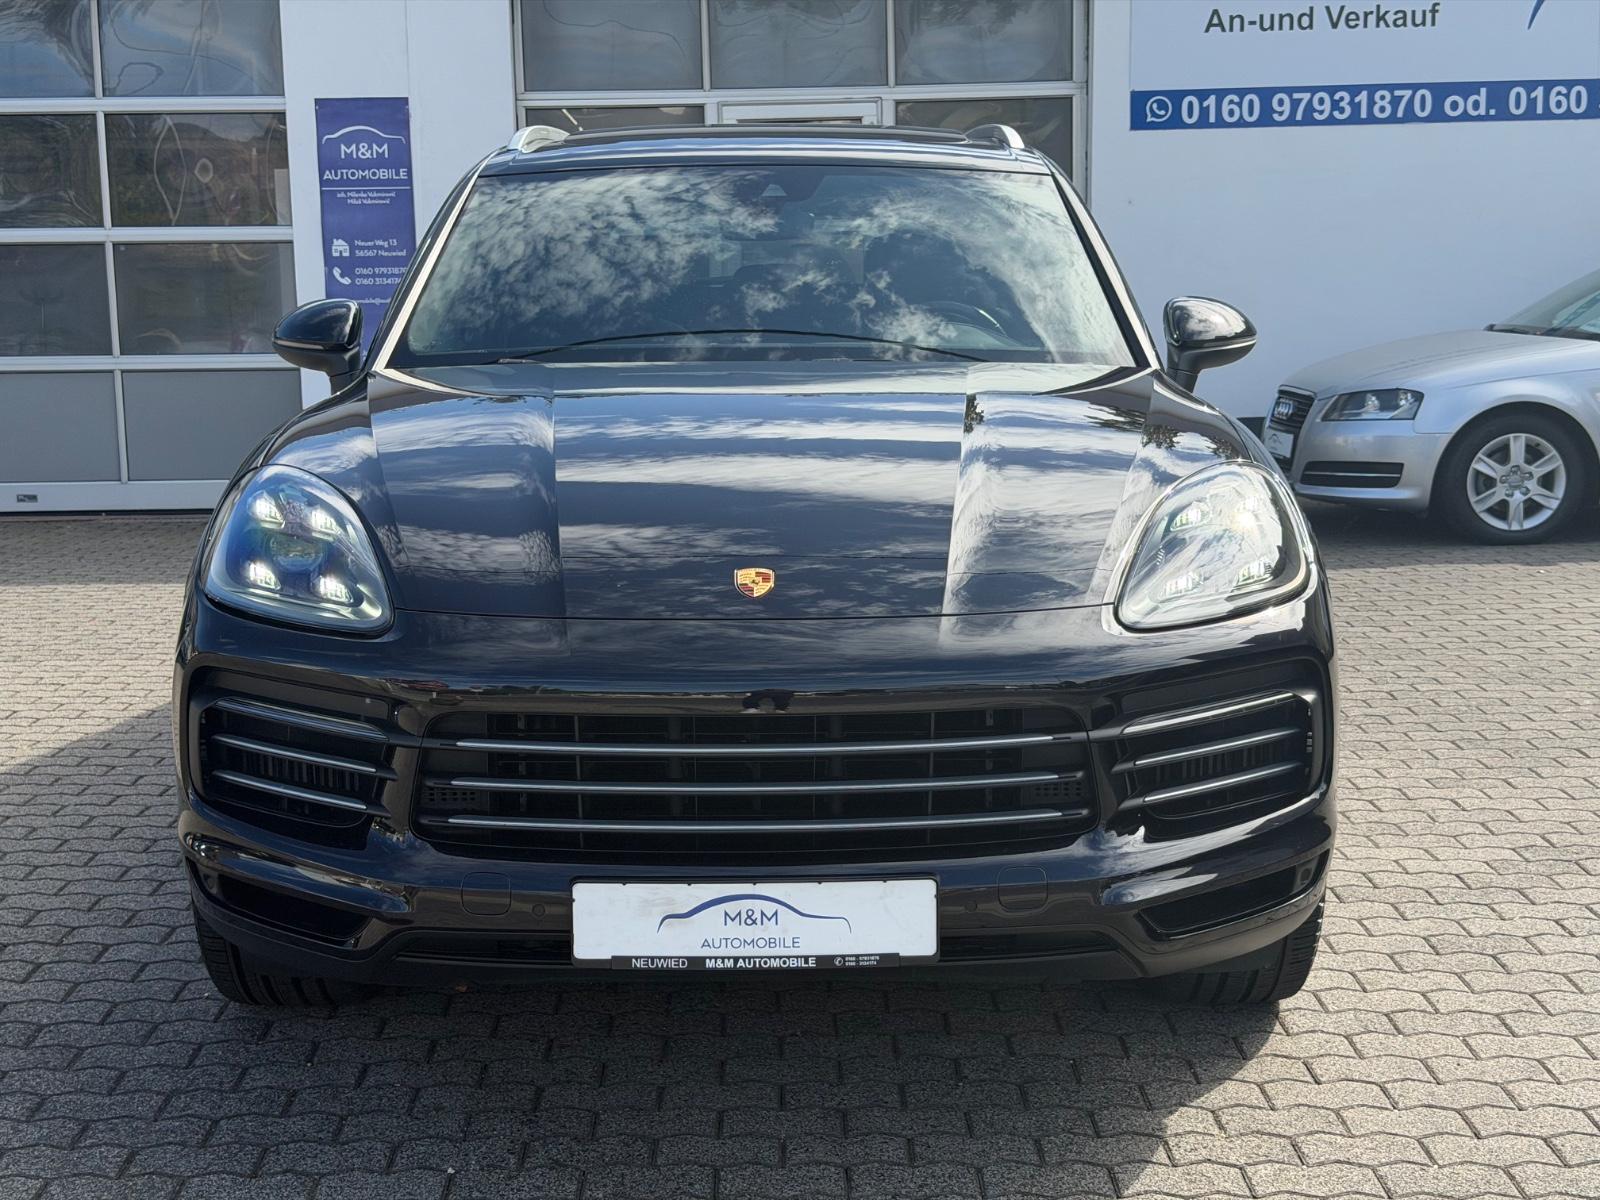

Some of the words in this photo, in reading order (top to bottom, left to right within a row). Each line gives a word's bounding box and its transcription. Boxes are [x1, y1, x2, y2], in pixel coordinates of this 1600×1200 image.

[1203, 5, 1315, 34] An-und
[1324, 2, 1441, 30] Verkauf
[1180, 94, 1261, 125] 0160
[1271, 89, 1433, 122] 97931870
[1443, 88, 1497, 117] od.
[1508, 85, 1588, 116] 0160
[340, 142, 389, 159] M&M
[322, 168, 409, 180] AUTOMOBILE
[355, 249, 377, 257] 56567
[355, 267, 373, 275] 0160
[355, 277, 374, 285] 0160
[723, 909, 780, 927] M&M
[700, 936, 802, 949] AUTOMOBILE
[631, 957, 688, 969] NEUWIED
[705, 957, 735, 969] M&M
[736, 956, 817, 969] AUTOMOBILE
